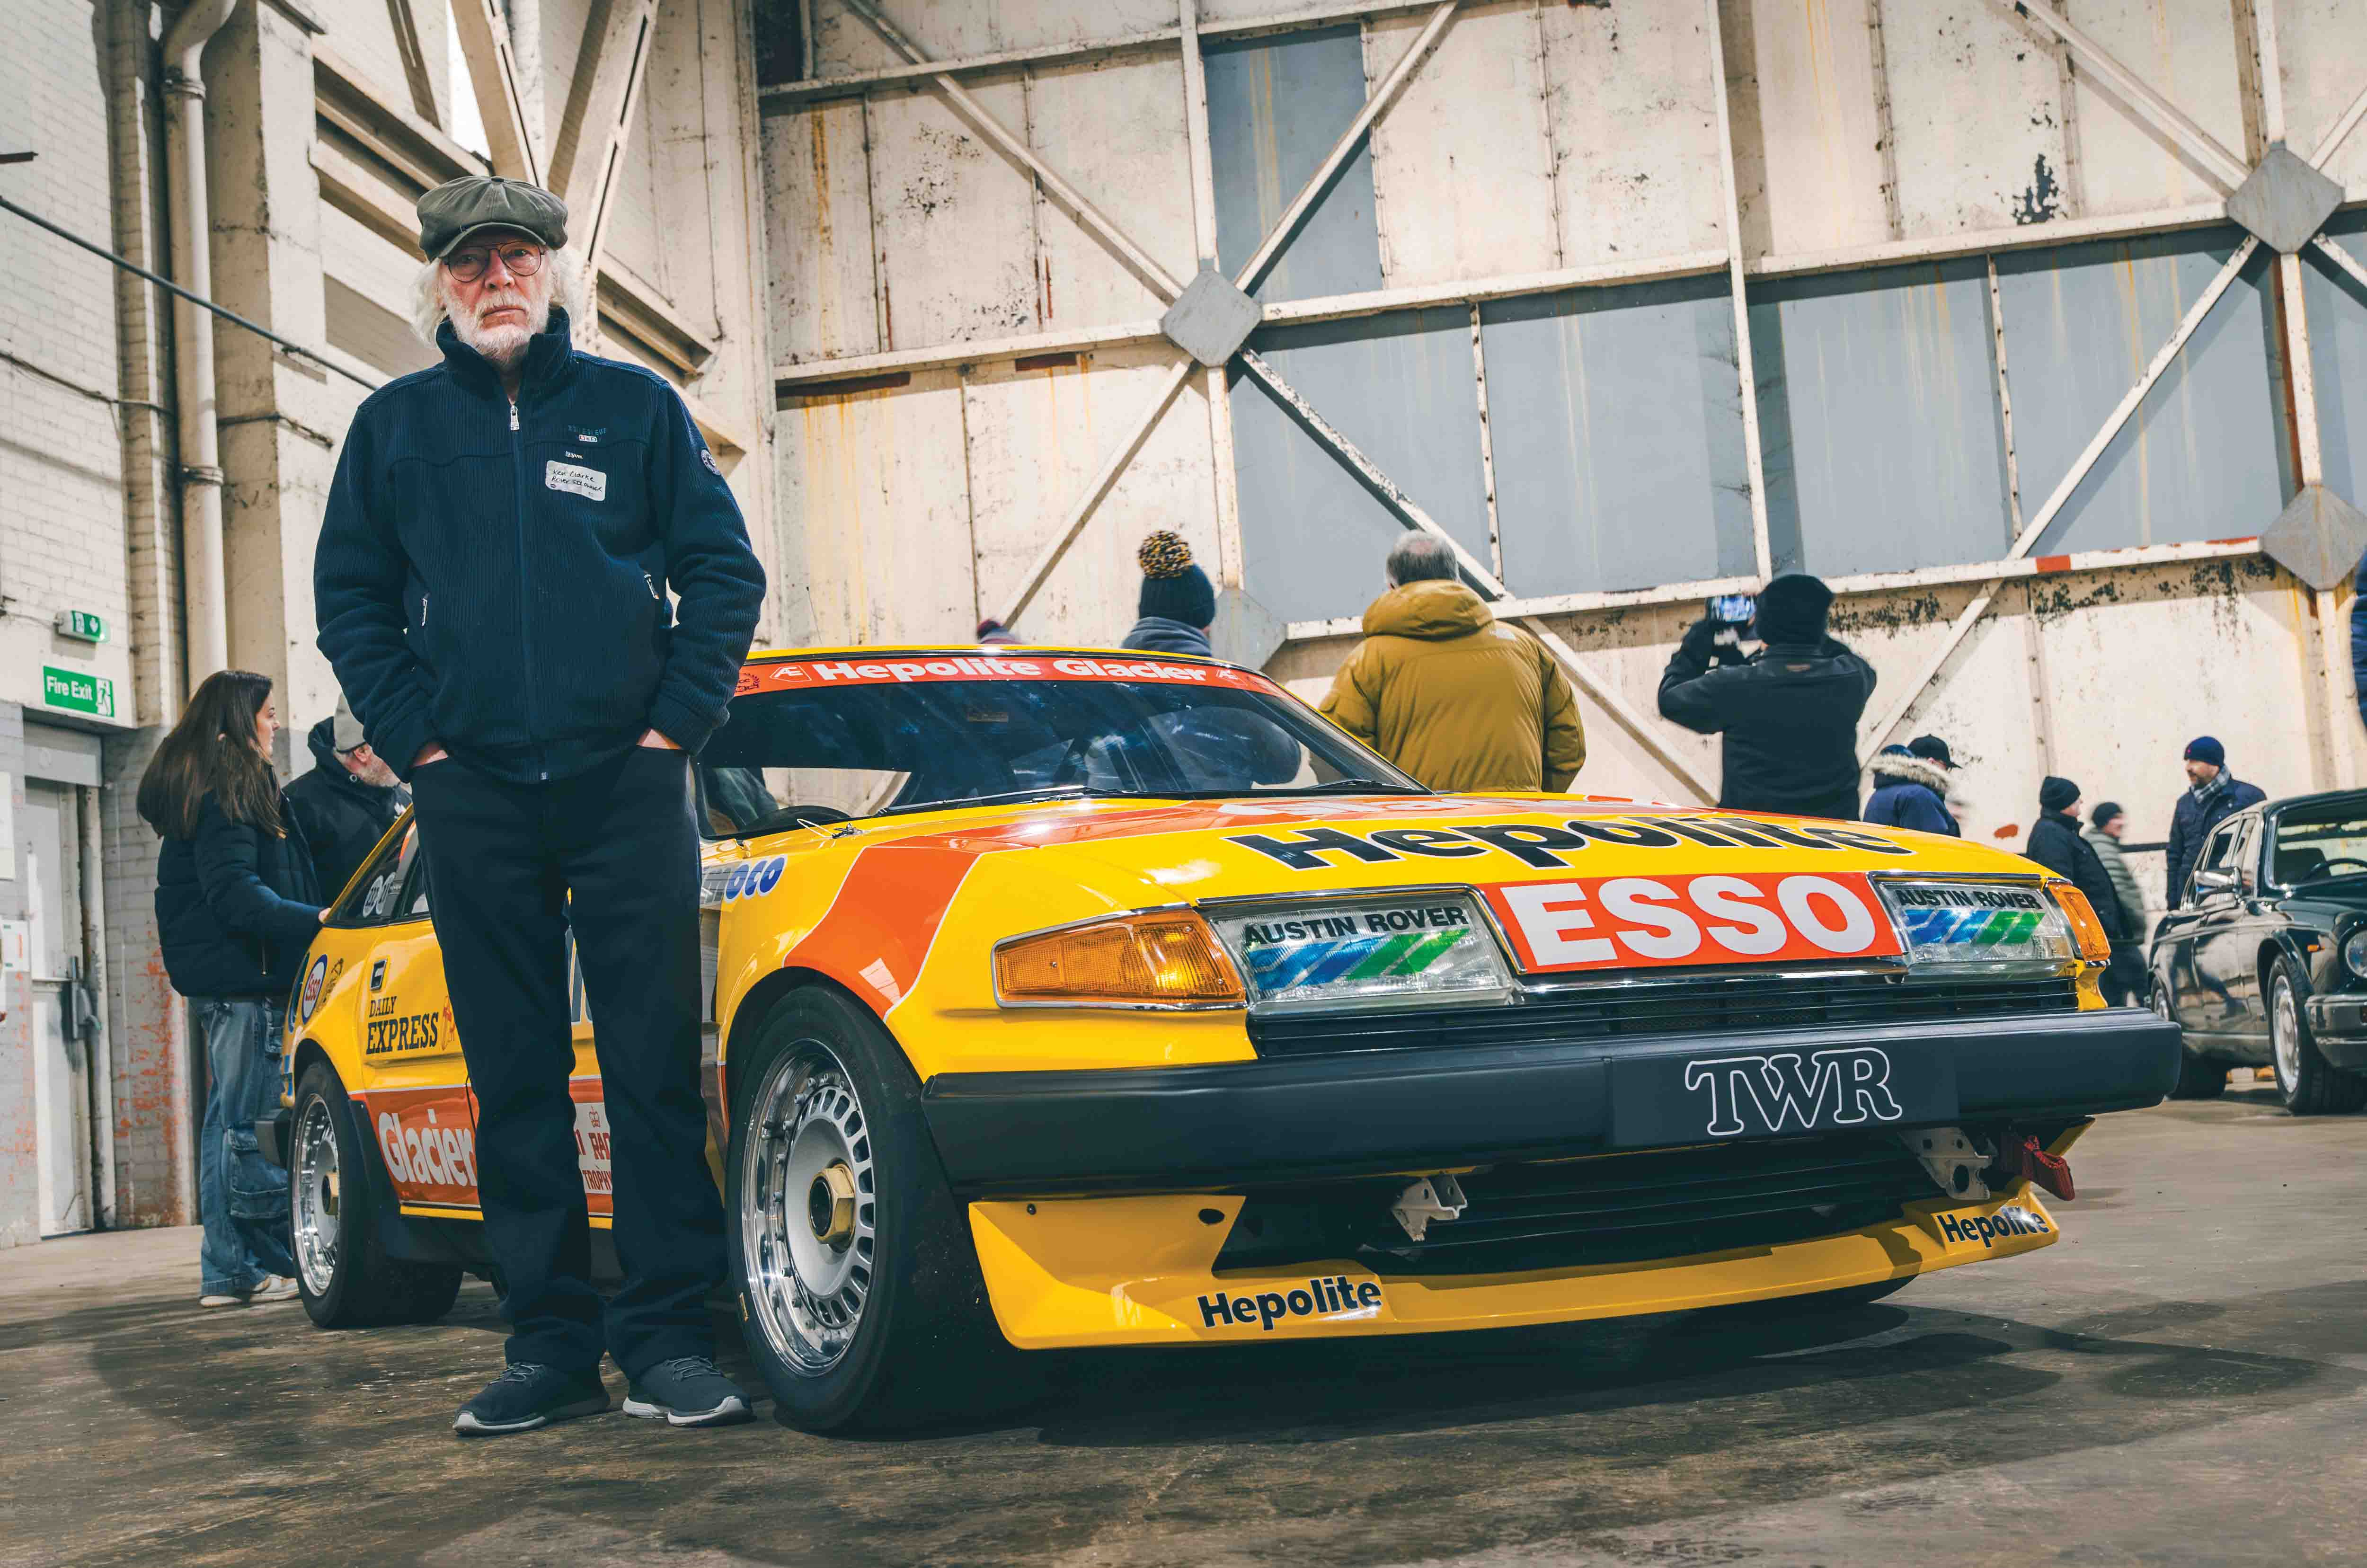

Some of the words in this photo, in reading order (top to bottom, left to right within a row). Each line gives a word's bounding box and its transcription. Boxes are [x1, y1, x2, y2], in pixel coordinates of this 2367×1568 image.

[46, 675, 70, 696] Fire
[71, 680, 93, 701] Exit
[812, 658, 1042, 682] Hepolite
[1053, 660, 1206, 682] Glacier
[1224, 816, 1916, 869] Hepolite
[1894, 889, 1973, 906] AUSTIN
[1973, 891, 2043, 909] ROVER
[1242, 916, 1359, 947] AUSTIN
[1365, 906, 1469, 933] ROVER
[1500, 876, 1876, 966] ESSO
[369, 995, 397, 1018] DAILY
[366, 1011, 439, 1054] EXPRESS
[1685, 1047, 1903, 1136] TWR
[378, 1108, 478, 1187] Glacier
[582, 1169, 612, 1190] TROPHY
[1937, 1205, 2050, 1249] Hepolite
[1197, 1275, 1383, 1331] Hepolite
